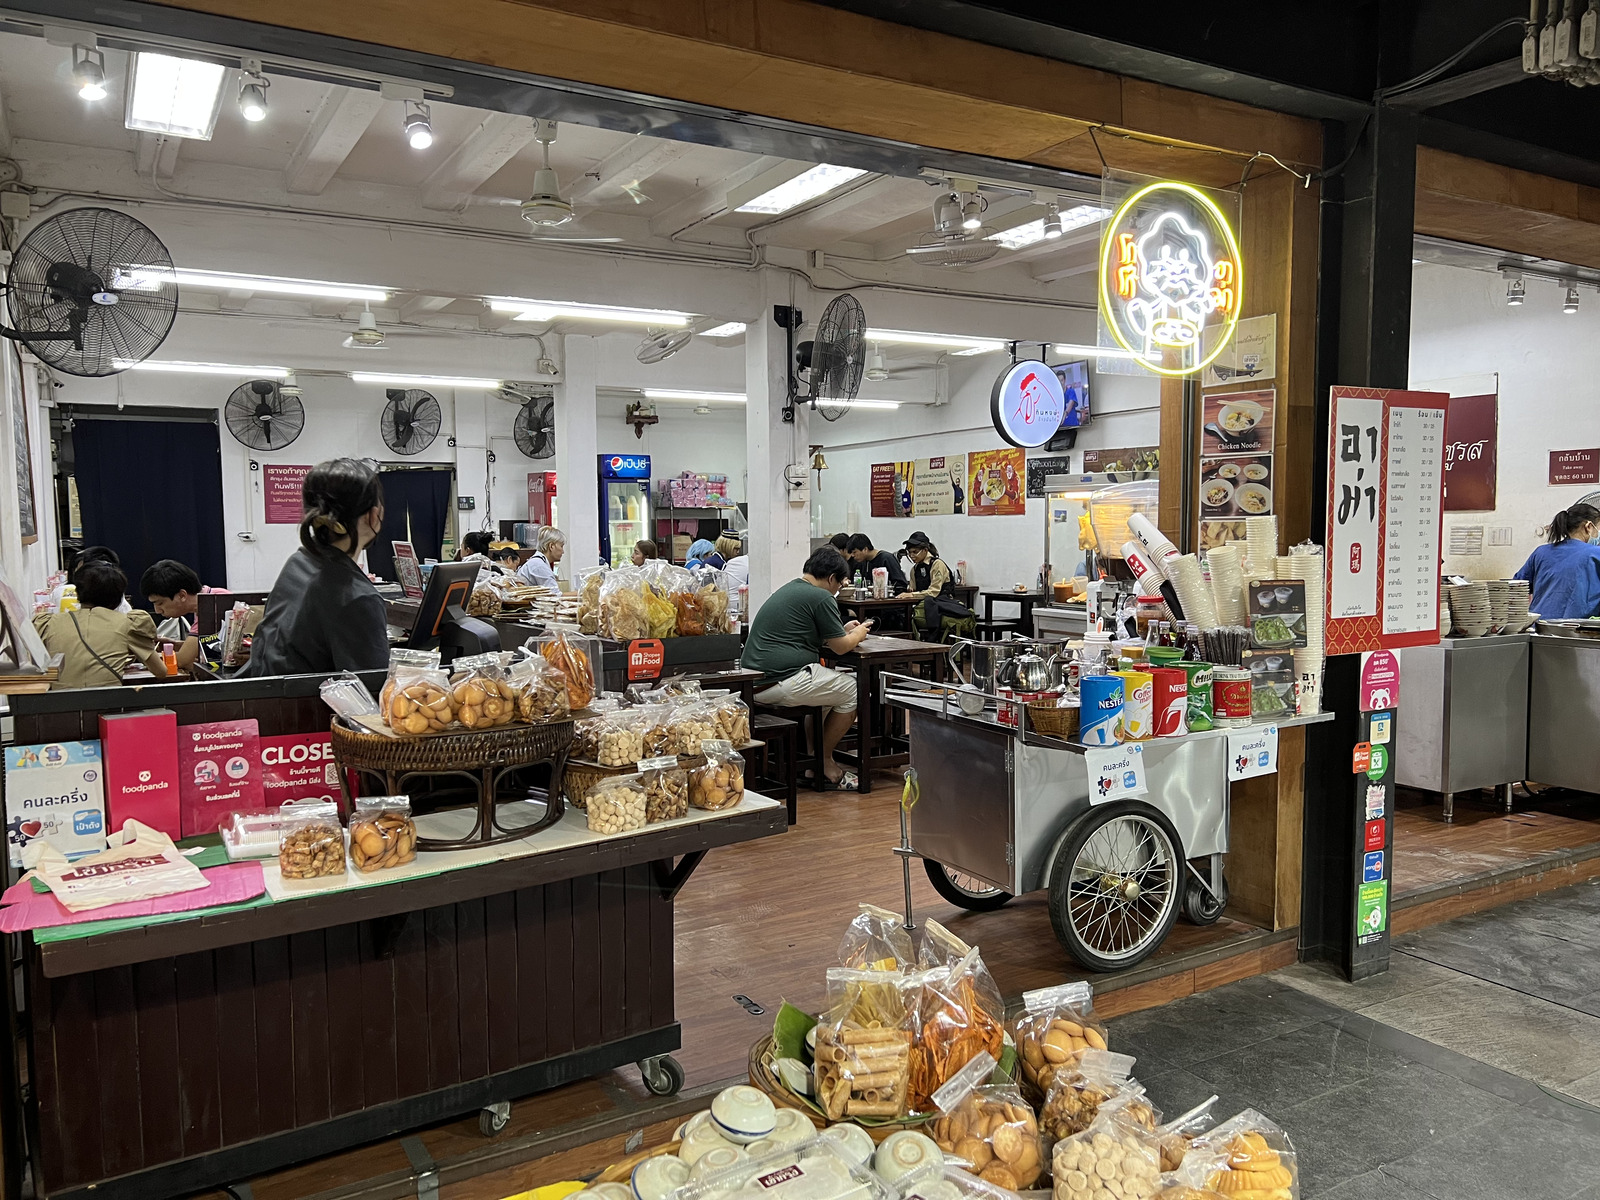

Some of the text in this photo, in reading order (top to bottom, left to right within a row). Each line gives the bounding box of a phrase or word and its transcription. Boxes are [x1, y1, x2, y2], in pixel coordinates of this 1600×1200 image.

[1217, 441, 1262, 450] Chicken Noodle
[1558, 451, 1591, 462] กลับบ้าน
[1169, 684, 1187, 693] NESC
[202, 730, 243, 740] foodpanda
[261, 742, 336, 766] CLOSE
[1103, 757, 1130, 771] คนละครึ่ง
[122, 781, 169, 794] foodpanda
[23, 787, 88, 809] คนละครึ่ง
[43, 820, 54, 829] 50
[76, 821, 100, 832] เป๋าตัง
[14, 834, 26, 842] 50
